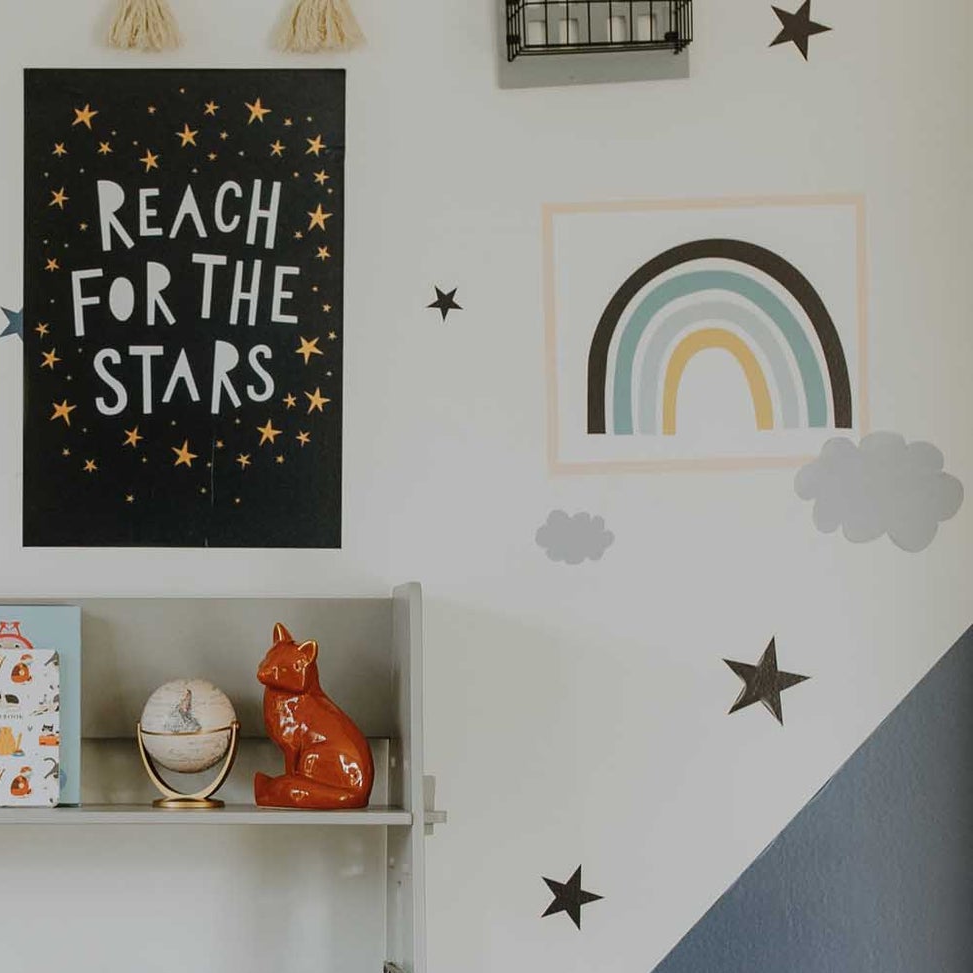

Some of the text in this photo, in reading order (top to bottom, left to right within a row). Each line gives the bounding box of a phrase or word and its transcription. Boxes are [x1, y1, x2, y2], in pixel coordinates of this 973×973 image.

[97, 179, 282, 252] REACH
[71, 253, 301, 337] FOR THE
[93, 339, 275, 416] STARS
